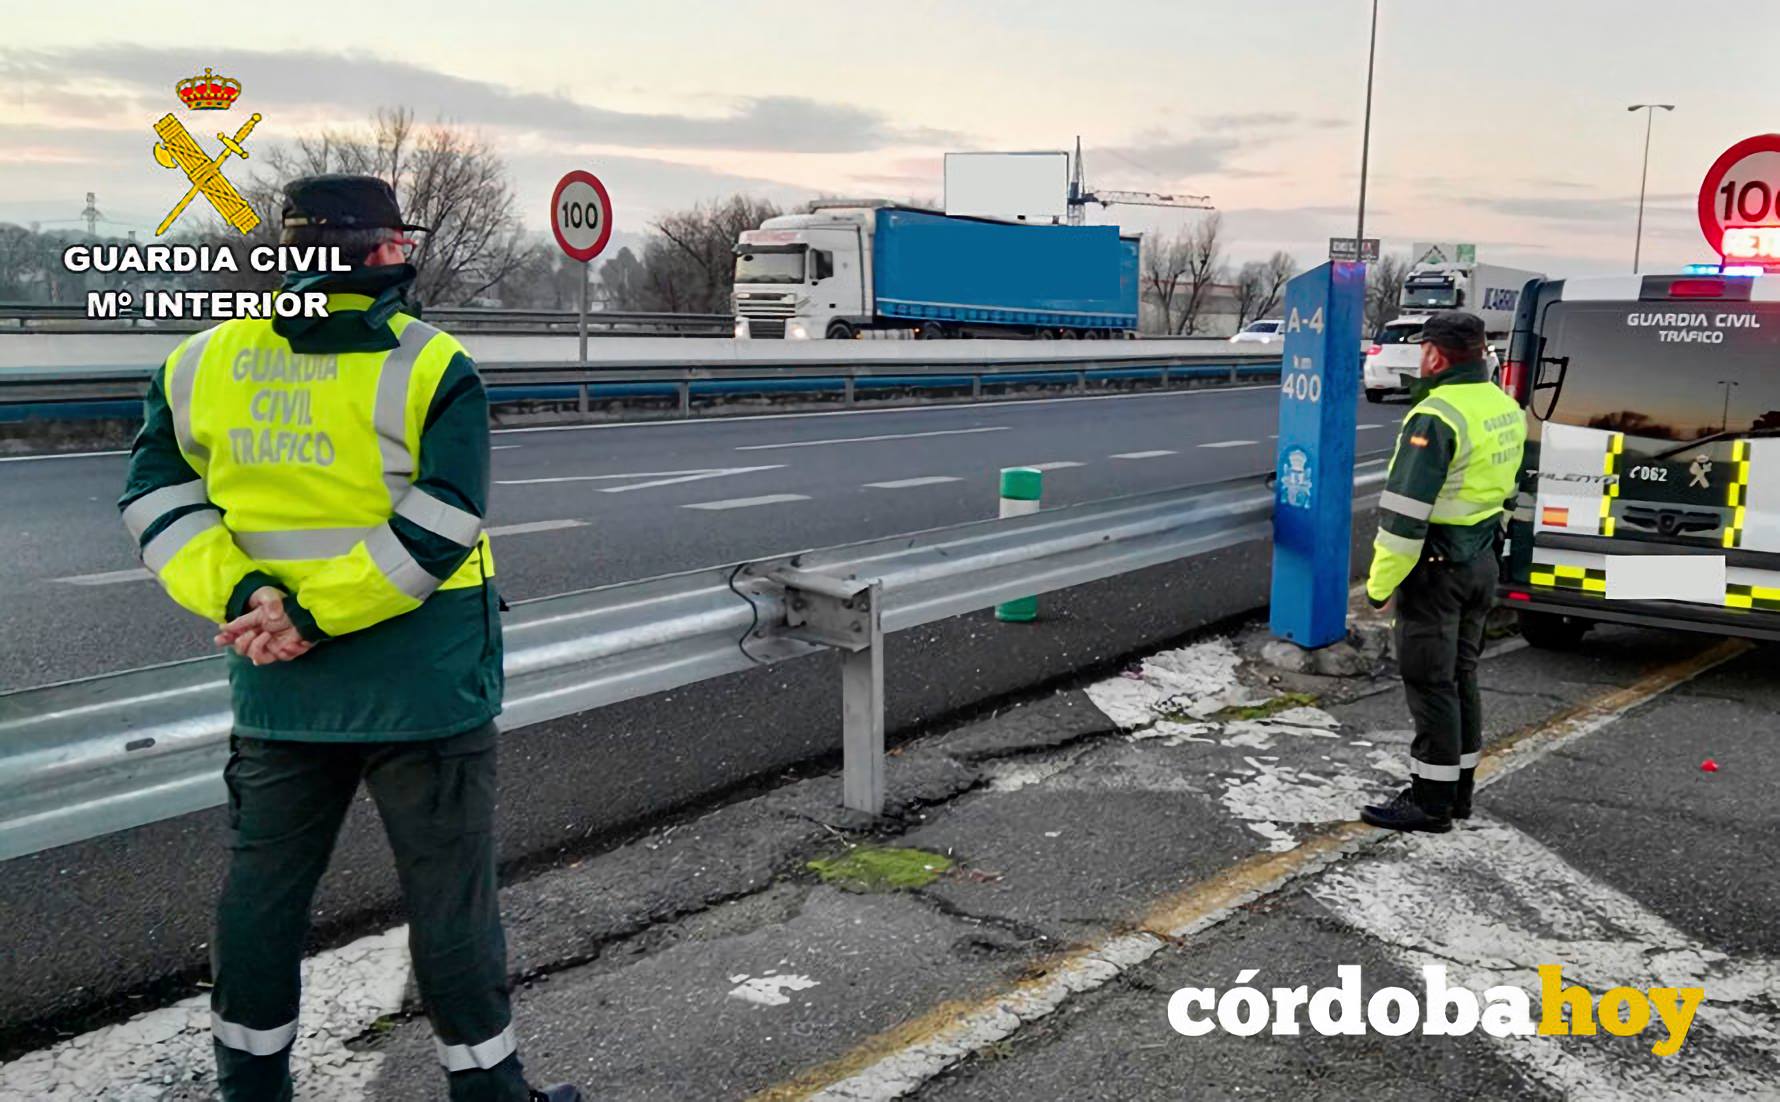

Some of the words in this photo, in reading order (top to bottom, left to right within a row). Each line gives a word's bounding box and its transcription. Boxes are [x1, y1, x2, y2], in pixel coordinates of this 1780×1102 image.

[562, 202, 598, 229] 100
[1721, 181, 1780, 222] 10
[1287, 307, 1325, 334] A-4
[1627, 313, 1708, 327] GUARDIA
[1715, 314, 1760, 328] CIVIL
[233, 347, 338, 382] GUARDIA
[1282, 373, 1322, 403] 400
[250, 389, 312, 425] CIVIL
[1640, 466, 1668, 482] 062
